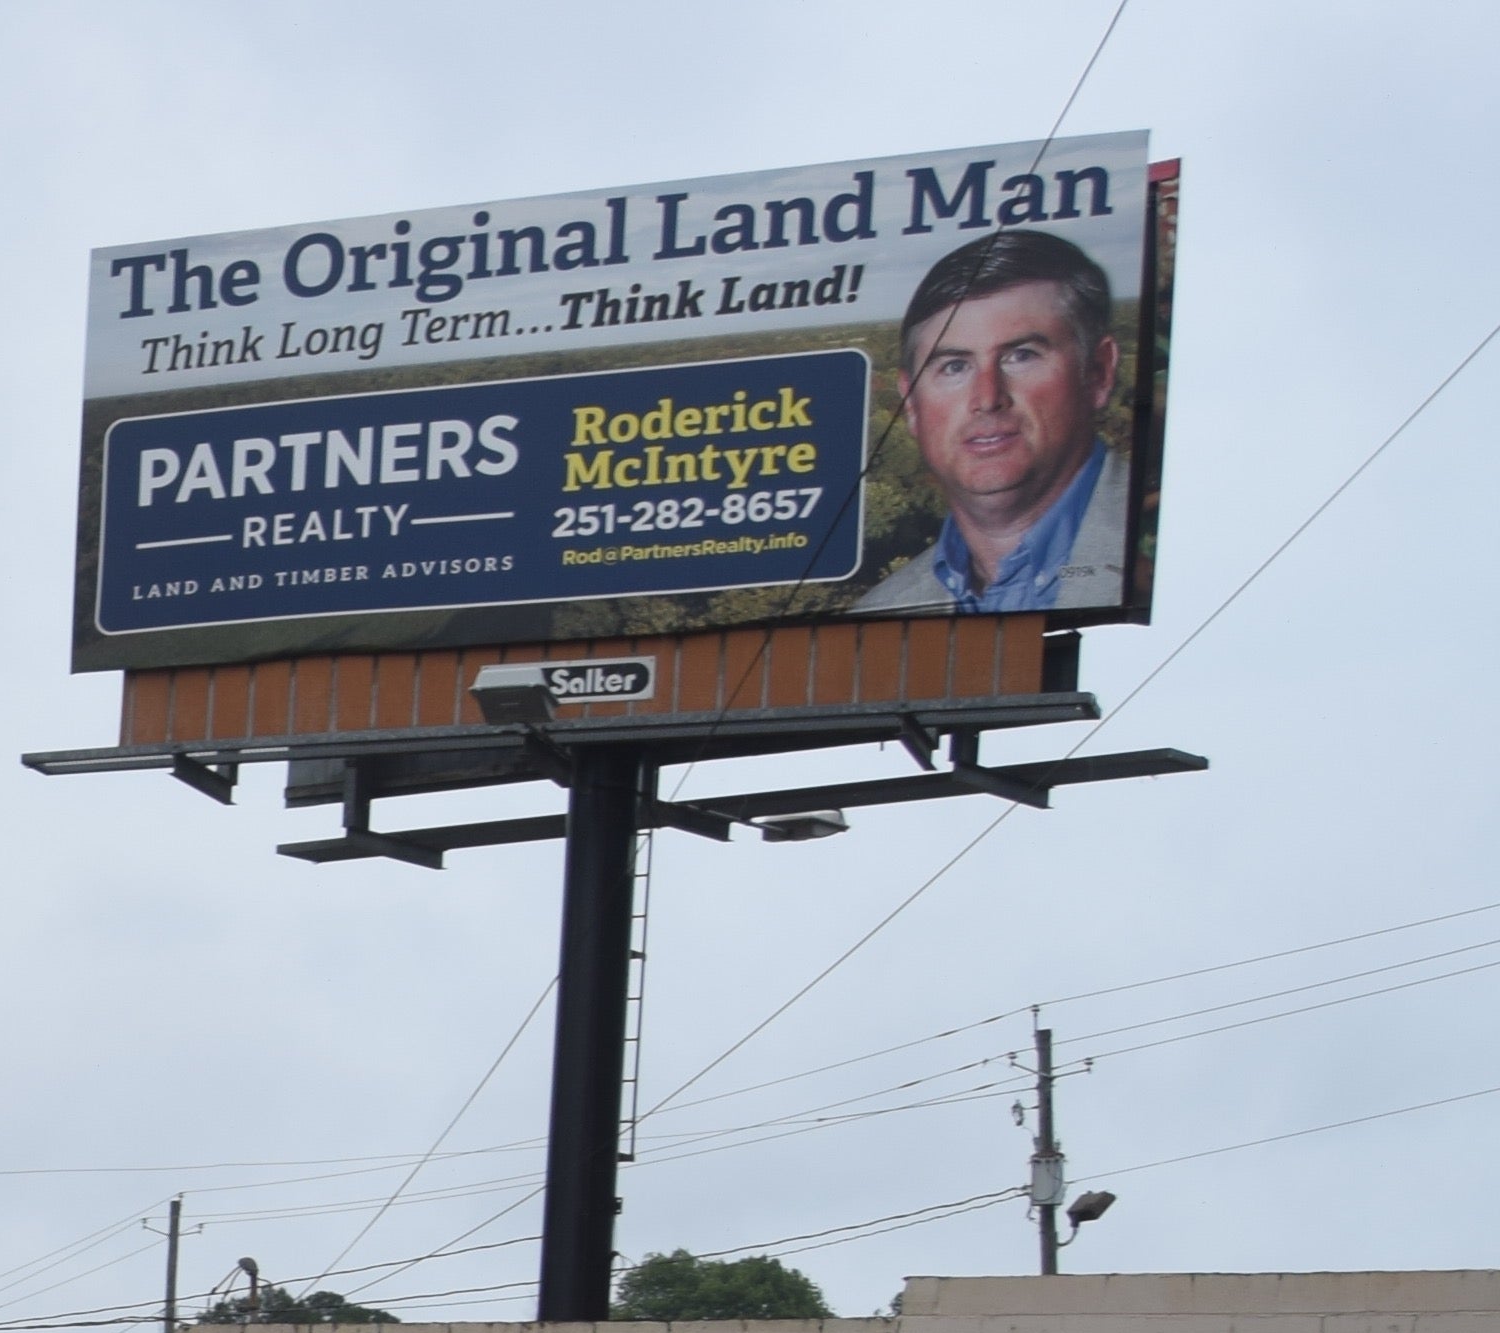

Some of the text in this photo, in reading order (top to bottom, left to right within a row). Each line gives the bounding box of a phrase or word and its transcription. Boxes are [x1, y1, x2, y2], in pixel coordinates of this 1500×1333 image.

[110, 159, 1113, 320] The Original Land Man
[141, 325, 265, 375] Think
[275, 321, 385, 361] Long
[714, 264, 865, 316] Land!
[570, 387, 813, 447] Roderick
[137, 414, 519, 507] PARTNERS
[562, 441, 817, 492] McIntyre
[242, 503, 411, 549] REALTY
[551, 487, 823, 538] 251-282-8657
[562, 531, 808, 566] Rod@PartnersRealty.info
[132, 554, 515, 600] LAND AND TIMBER ADVISORS
[549, 667, 638, 695] Salter
